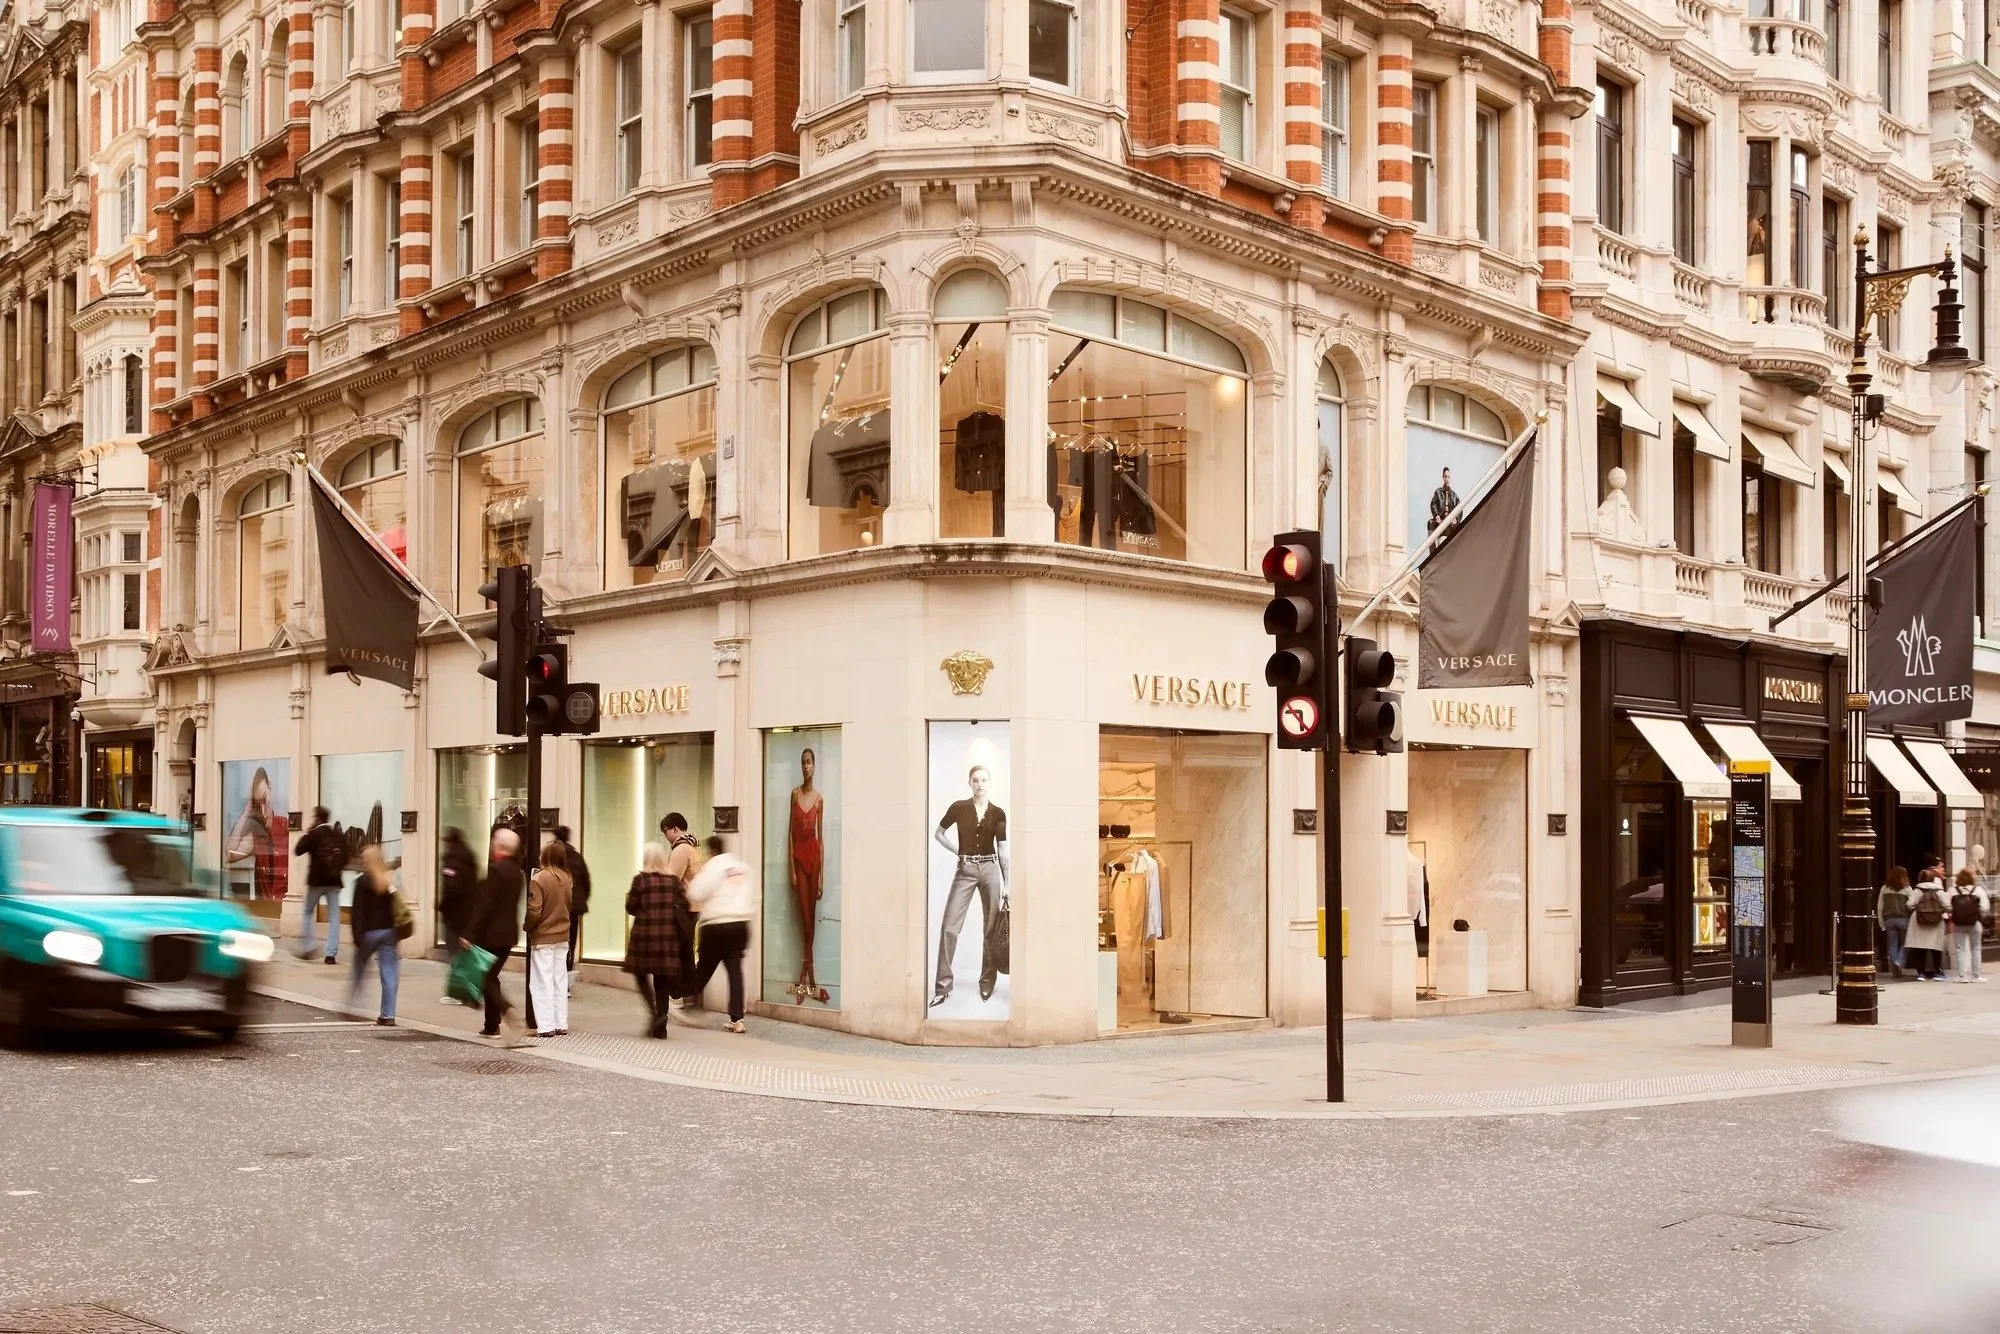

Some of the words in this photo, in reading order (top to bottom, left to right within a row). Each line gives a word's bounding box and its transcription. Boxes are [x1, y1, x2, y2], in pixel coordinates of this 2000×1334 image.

[47, 504, 57, 560] MORELLE
[46, 563, 55, 620] DAVIDSON
[340, 647, 409, 672] VERSACE
[1438, 653, 1517, 670] VERSACE
[1130, 673, 1252, 709] VERSACE
[1868, 684, 1974, 706] MONCLER
[1429, 698, 1517, 728] VERSACE
